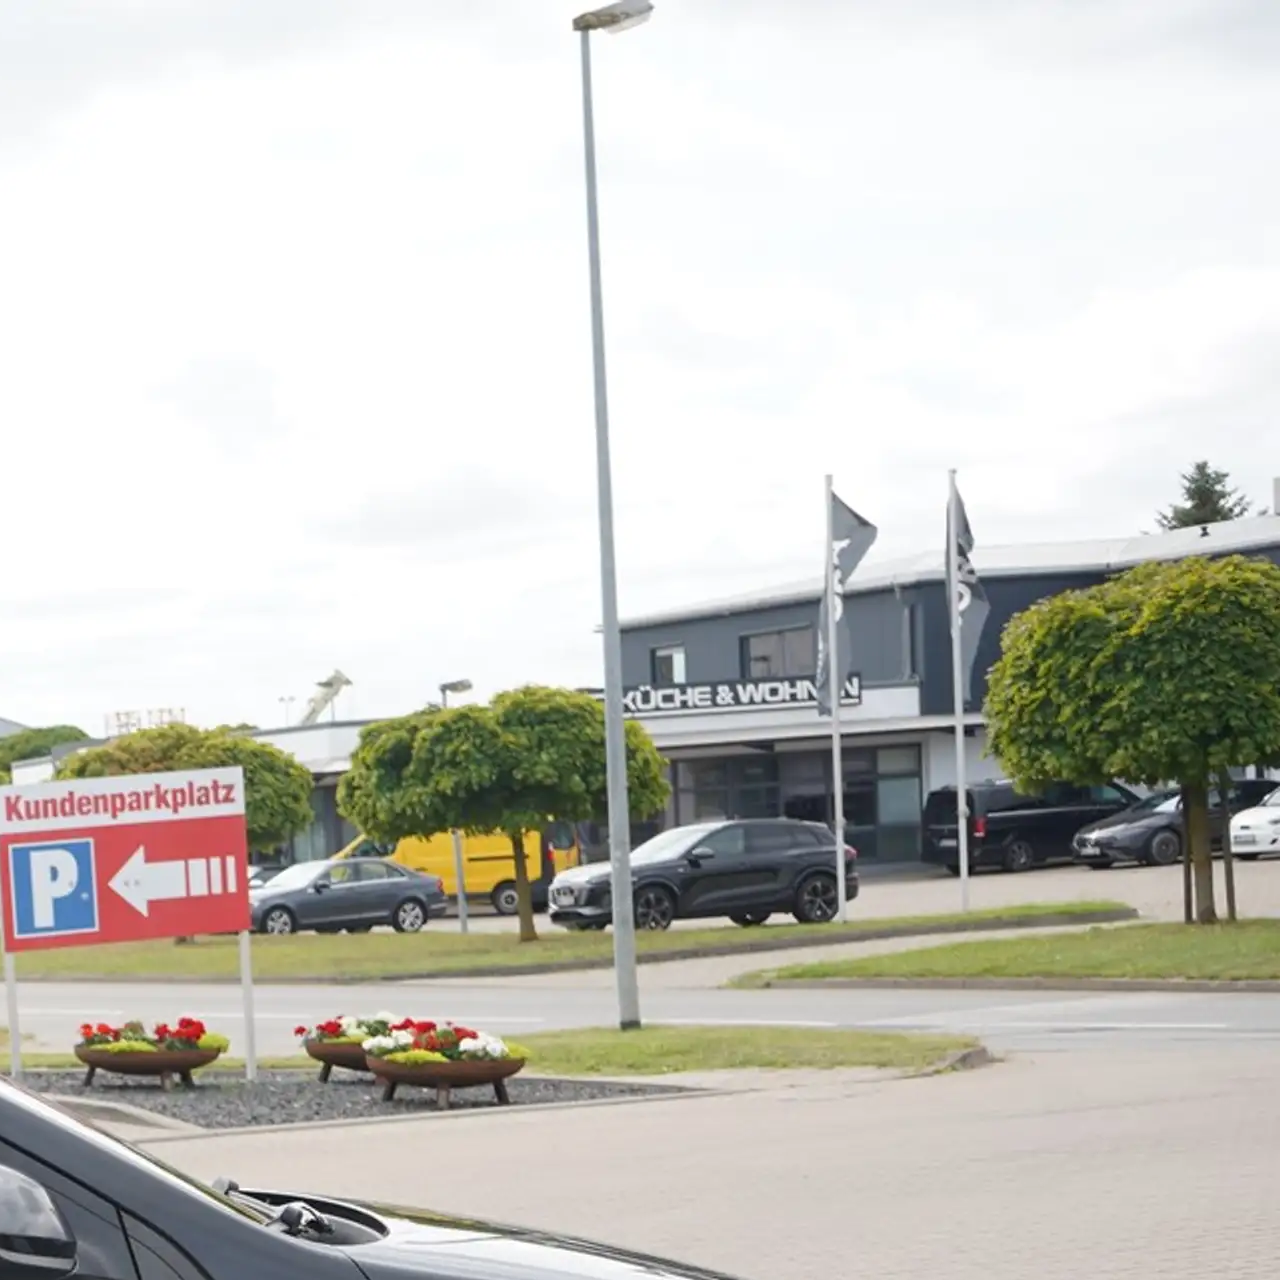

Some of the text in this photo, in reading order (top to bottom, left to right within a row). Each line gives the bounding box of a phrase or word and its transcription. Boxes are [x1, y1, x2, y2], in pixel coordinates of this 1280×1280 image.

[716, 687, 735, 706] &
[736, 676, 859, 704] WOHNN
[4, 779, 236, 821] Kundenparkplatz
[29, 848, 79, 929] P
